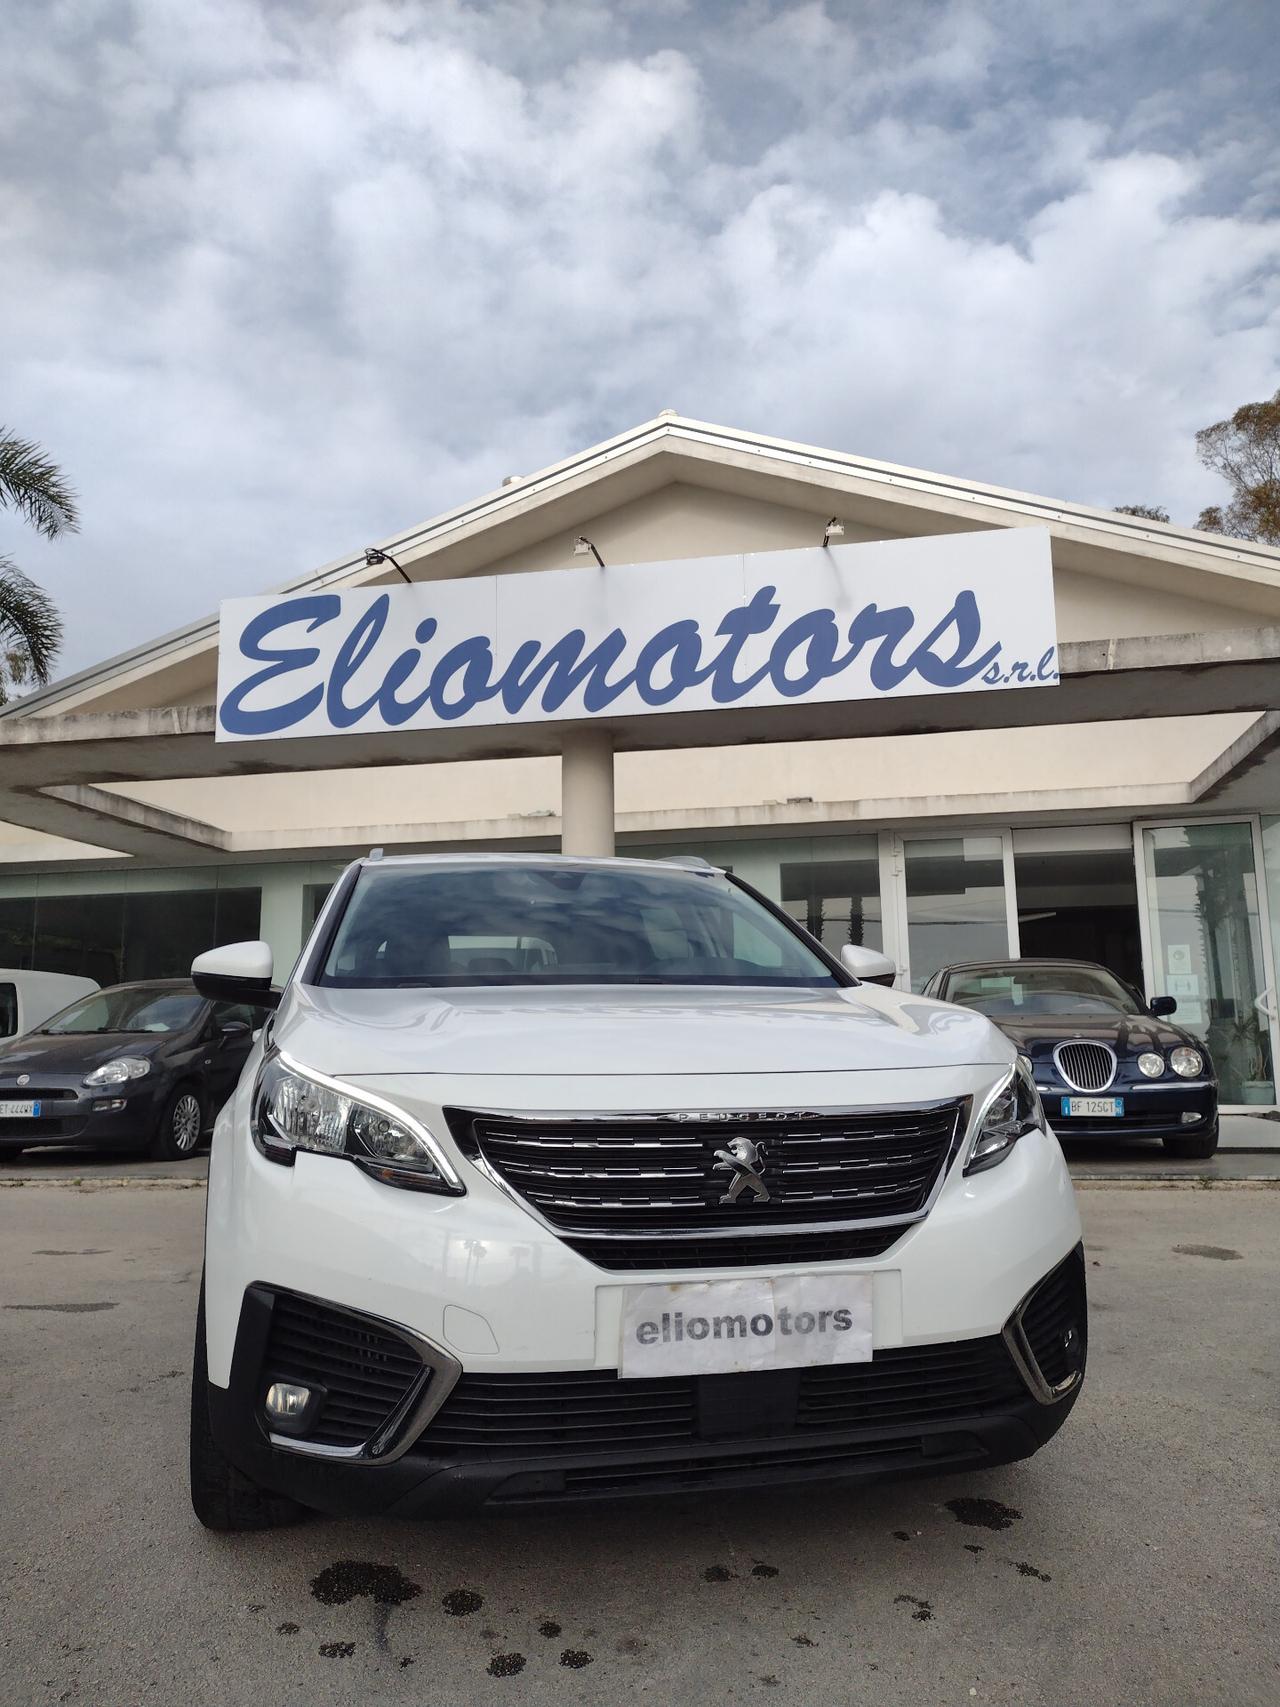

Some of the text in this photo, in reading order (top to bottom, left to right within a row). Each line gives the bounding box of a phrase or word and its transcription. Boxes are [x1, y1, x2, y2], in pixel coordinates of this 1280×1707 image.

[219, 585, 1060, 736] Eliomotors s.r.l.
[678, 1111, 807, 1123] PEUGEOT
[635, 1306, 853, 1345] eliomotors
